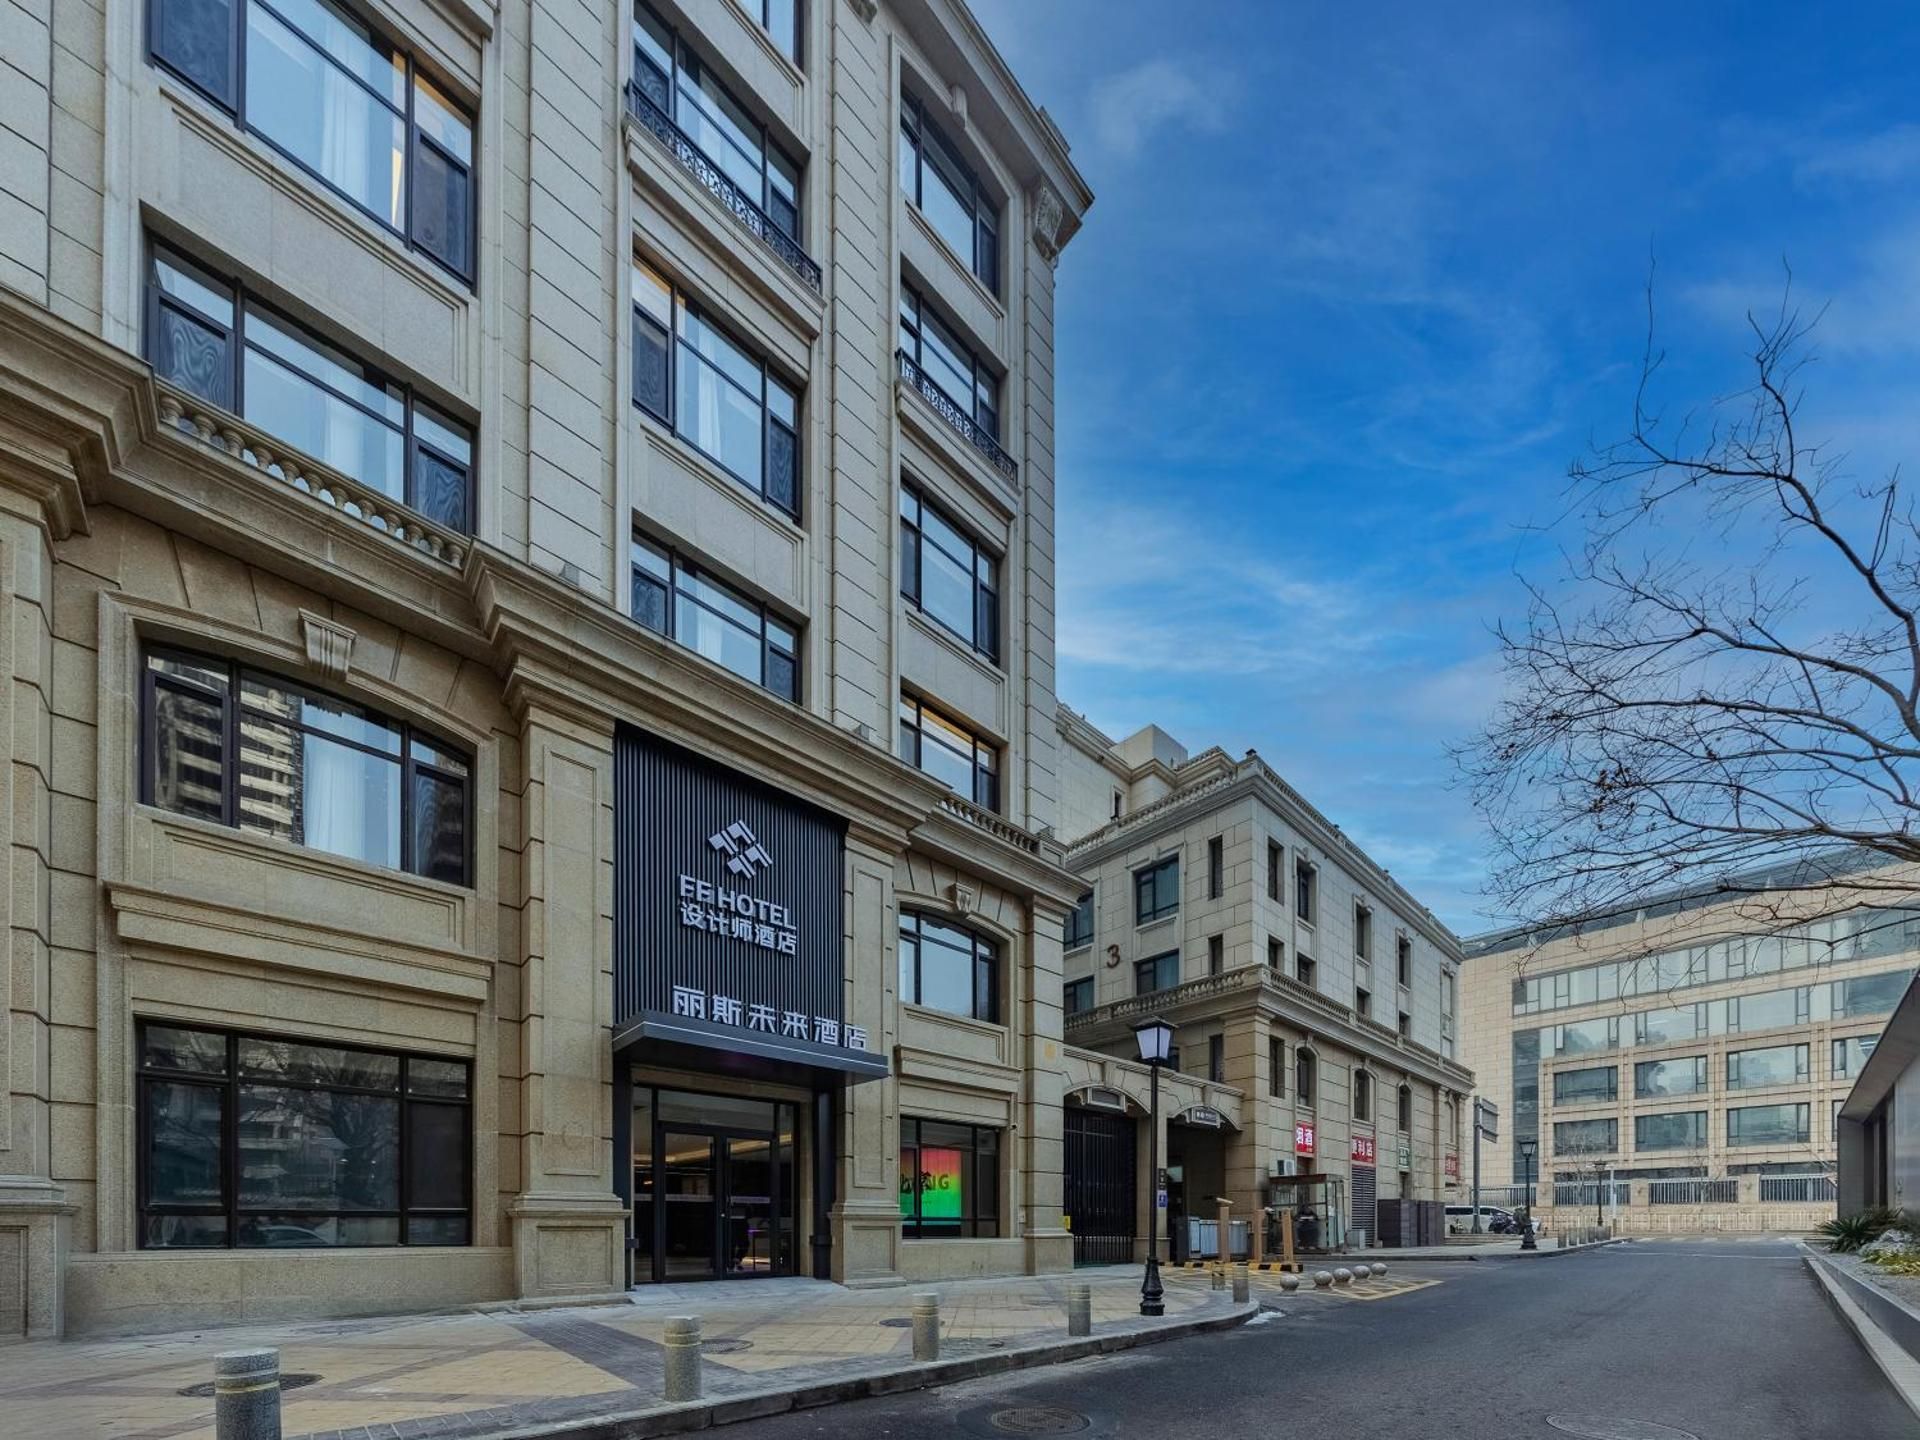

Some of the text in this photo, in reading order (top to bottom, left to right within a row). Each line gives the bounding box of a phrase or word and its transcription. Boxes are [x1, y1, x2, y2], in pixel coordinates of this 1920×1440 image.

[680, 901, 797, 956] 设计师酒店
[717, 887, 797, 930] HOTEL
[1106, 944, 1121, 969] 3
